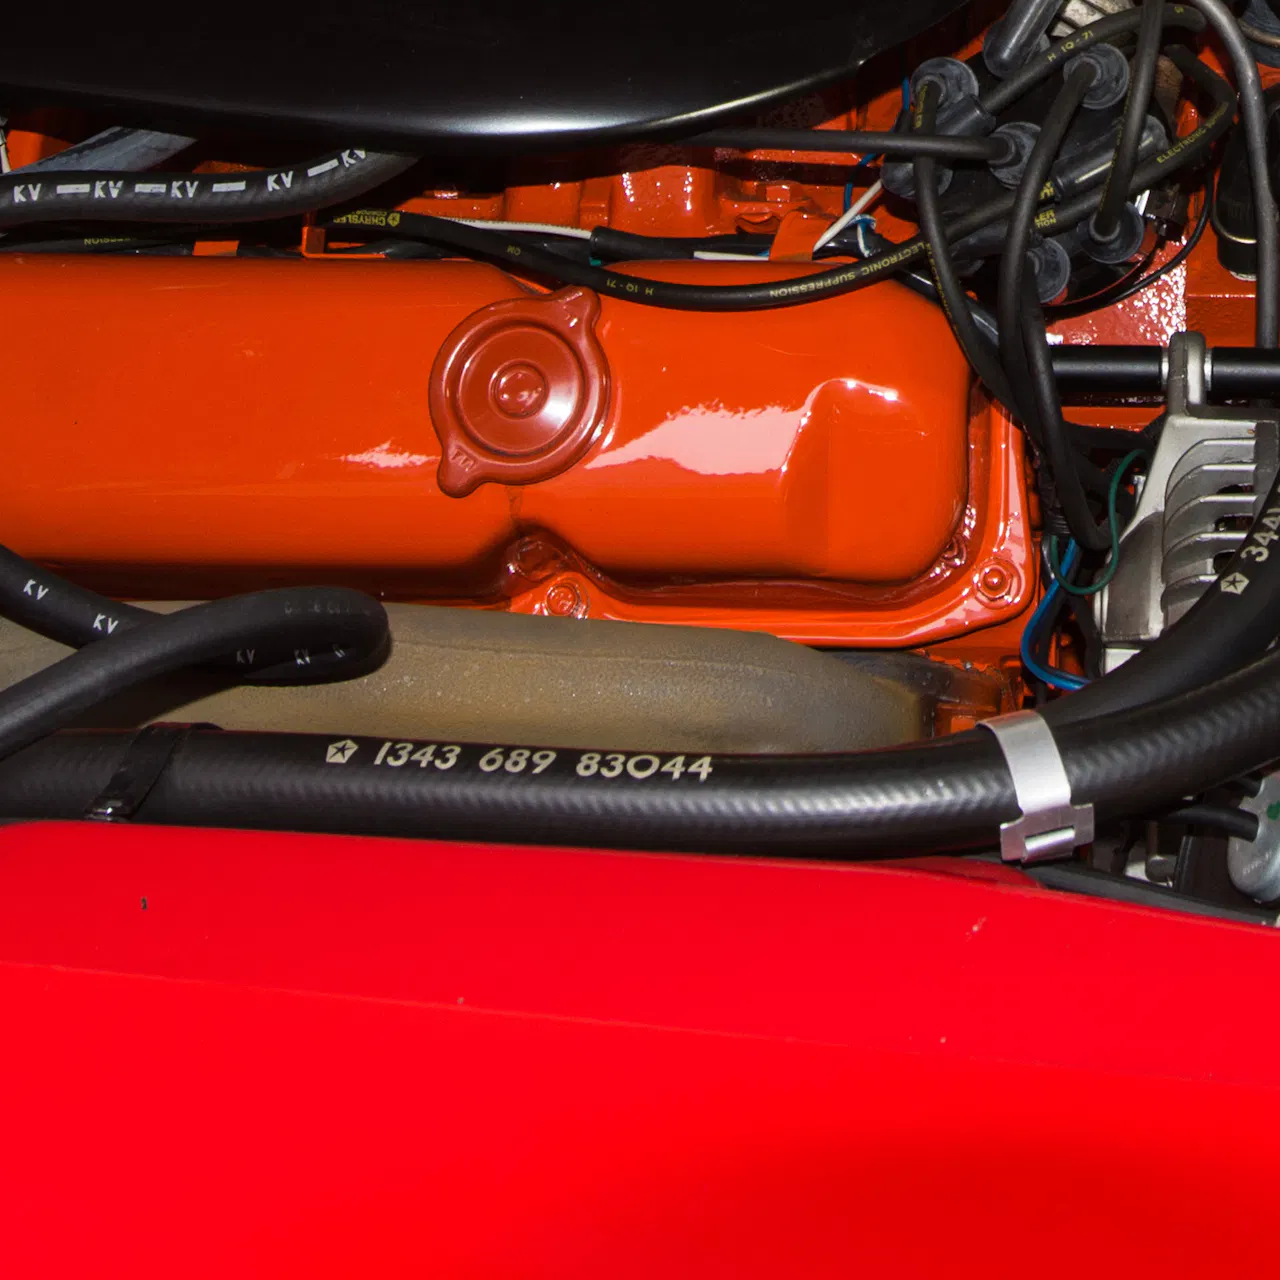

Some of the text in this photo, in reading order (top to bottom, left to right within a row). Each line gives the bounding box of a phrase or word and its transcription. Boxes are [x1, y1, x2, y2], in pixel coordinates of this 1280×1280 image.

[1156, 126, 1207, 164] ELECTRONIC
[12, 183, 42, 204] KV
[92, 179, 122, 200] KV
[170, 179, 200, 200] KV
[266, 169, 295, 193] KV
[339, 146, 369, 170] KV
[769, 241, 926, 298] LECTRONIC SUPPRESSION
[23, 578, 49, 601] KV
[92, 612, 119, 636] KV
[373, 741, 714, 783] 1343 689 83044
